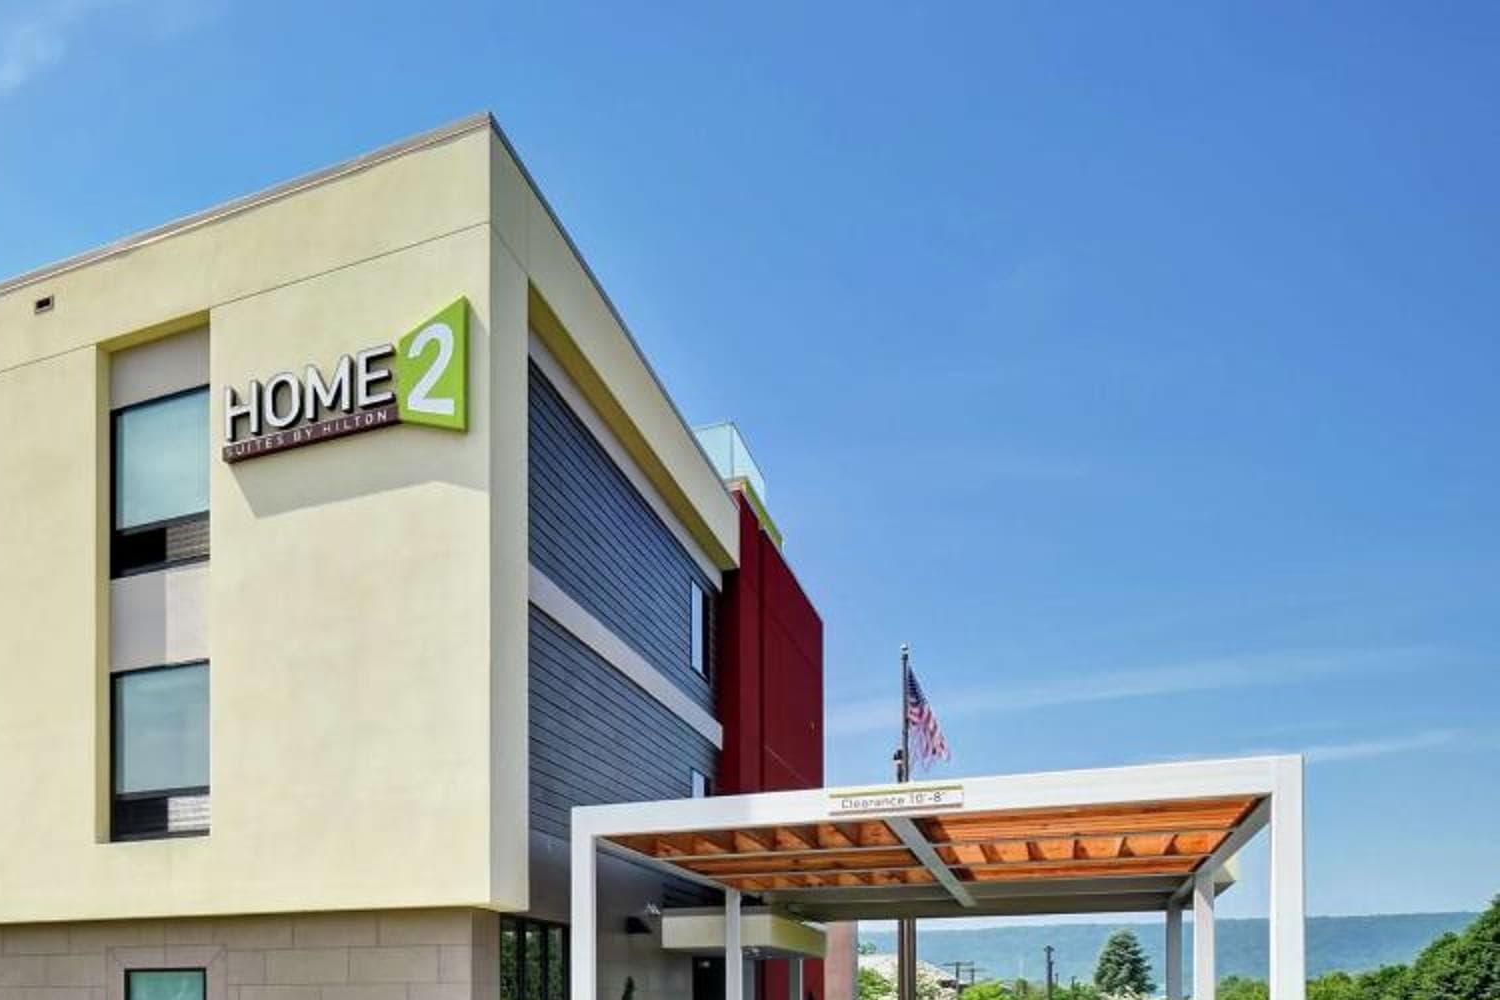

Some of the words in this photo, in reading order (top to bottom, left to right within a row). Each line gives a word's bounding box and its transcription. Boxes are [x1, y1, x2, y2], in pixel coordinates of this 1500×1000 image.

[224, 343, 395, 441] HOME
[407, 322, 455, 417] 2
[226, 434, 284, 456] SUITES
[293, 428, 314, 441] BY
[323, 411, 388, 433] HILTON
[841, 797, 905, 809] Clearance
